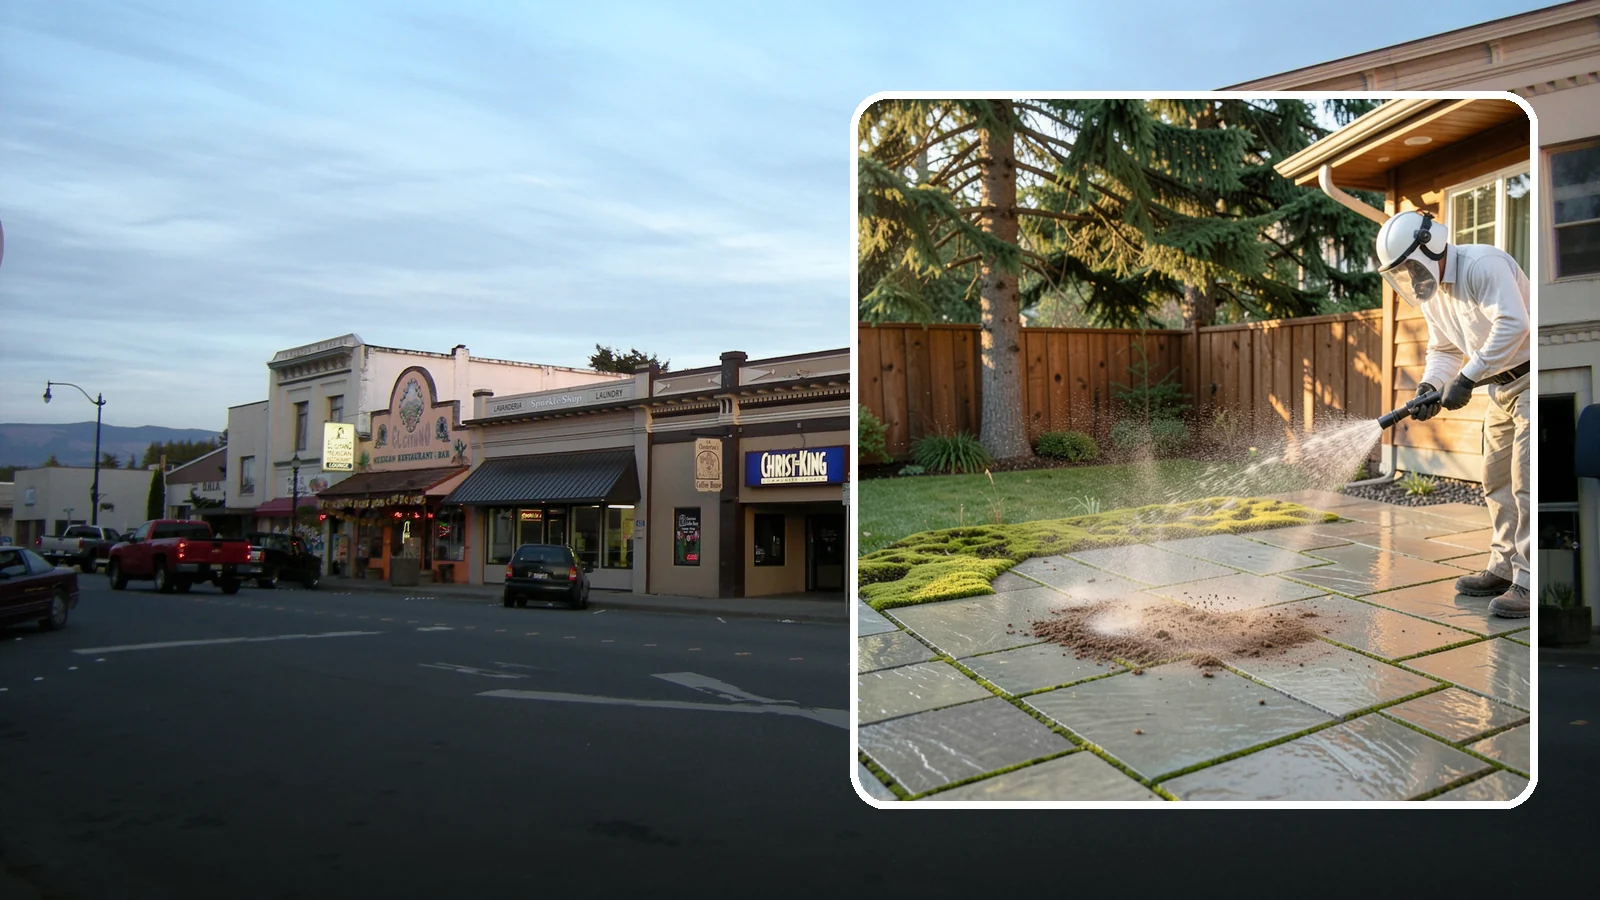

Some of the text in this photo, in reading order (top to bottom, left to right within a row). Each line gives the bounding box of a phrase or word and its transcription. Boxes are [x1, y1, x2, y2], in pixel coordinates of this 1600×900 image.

[531, 394, 582, 409] Sparkle Shop
[595, 389, 623, 400] LAUNDRY
[493, 402, 522, 412] LAVANDERIA
[373, 455, 396, 465] MEXICAN
[398, 452, 433, 462] RESTAURANT
[438, 450, 449, 459] BAR
[760, 450, 828, 478] CHRIST KING
